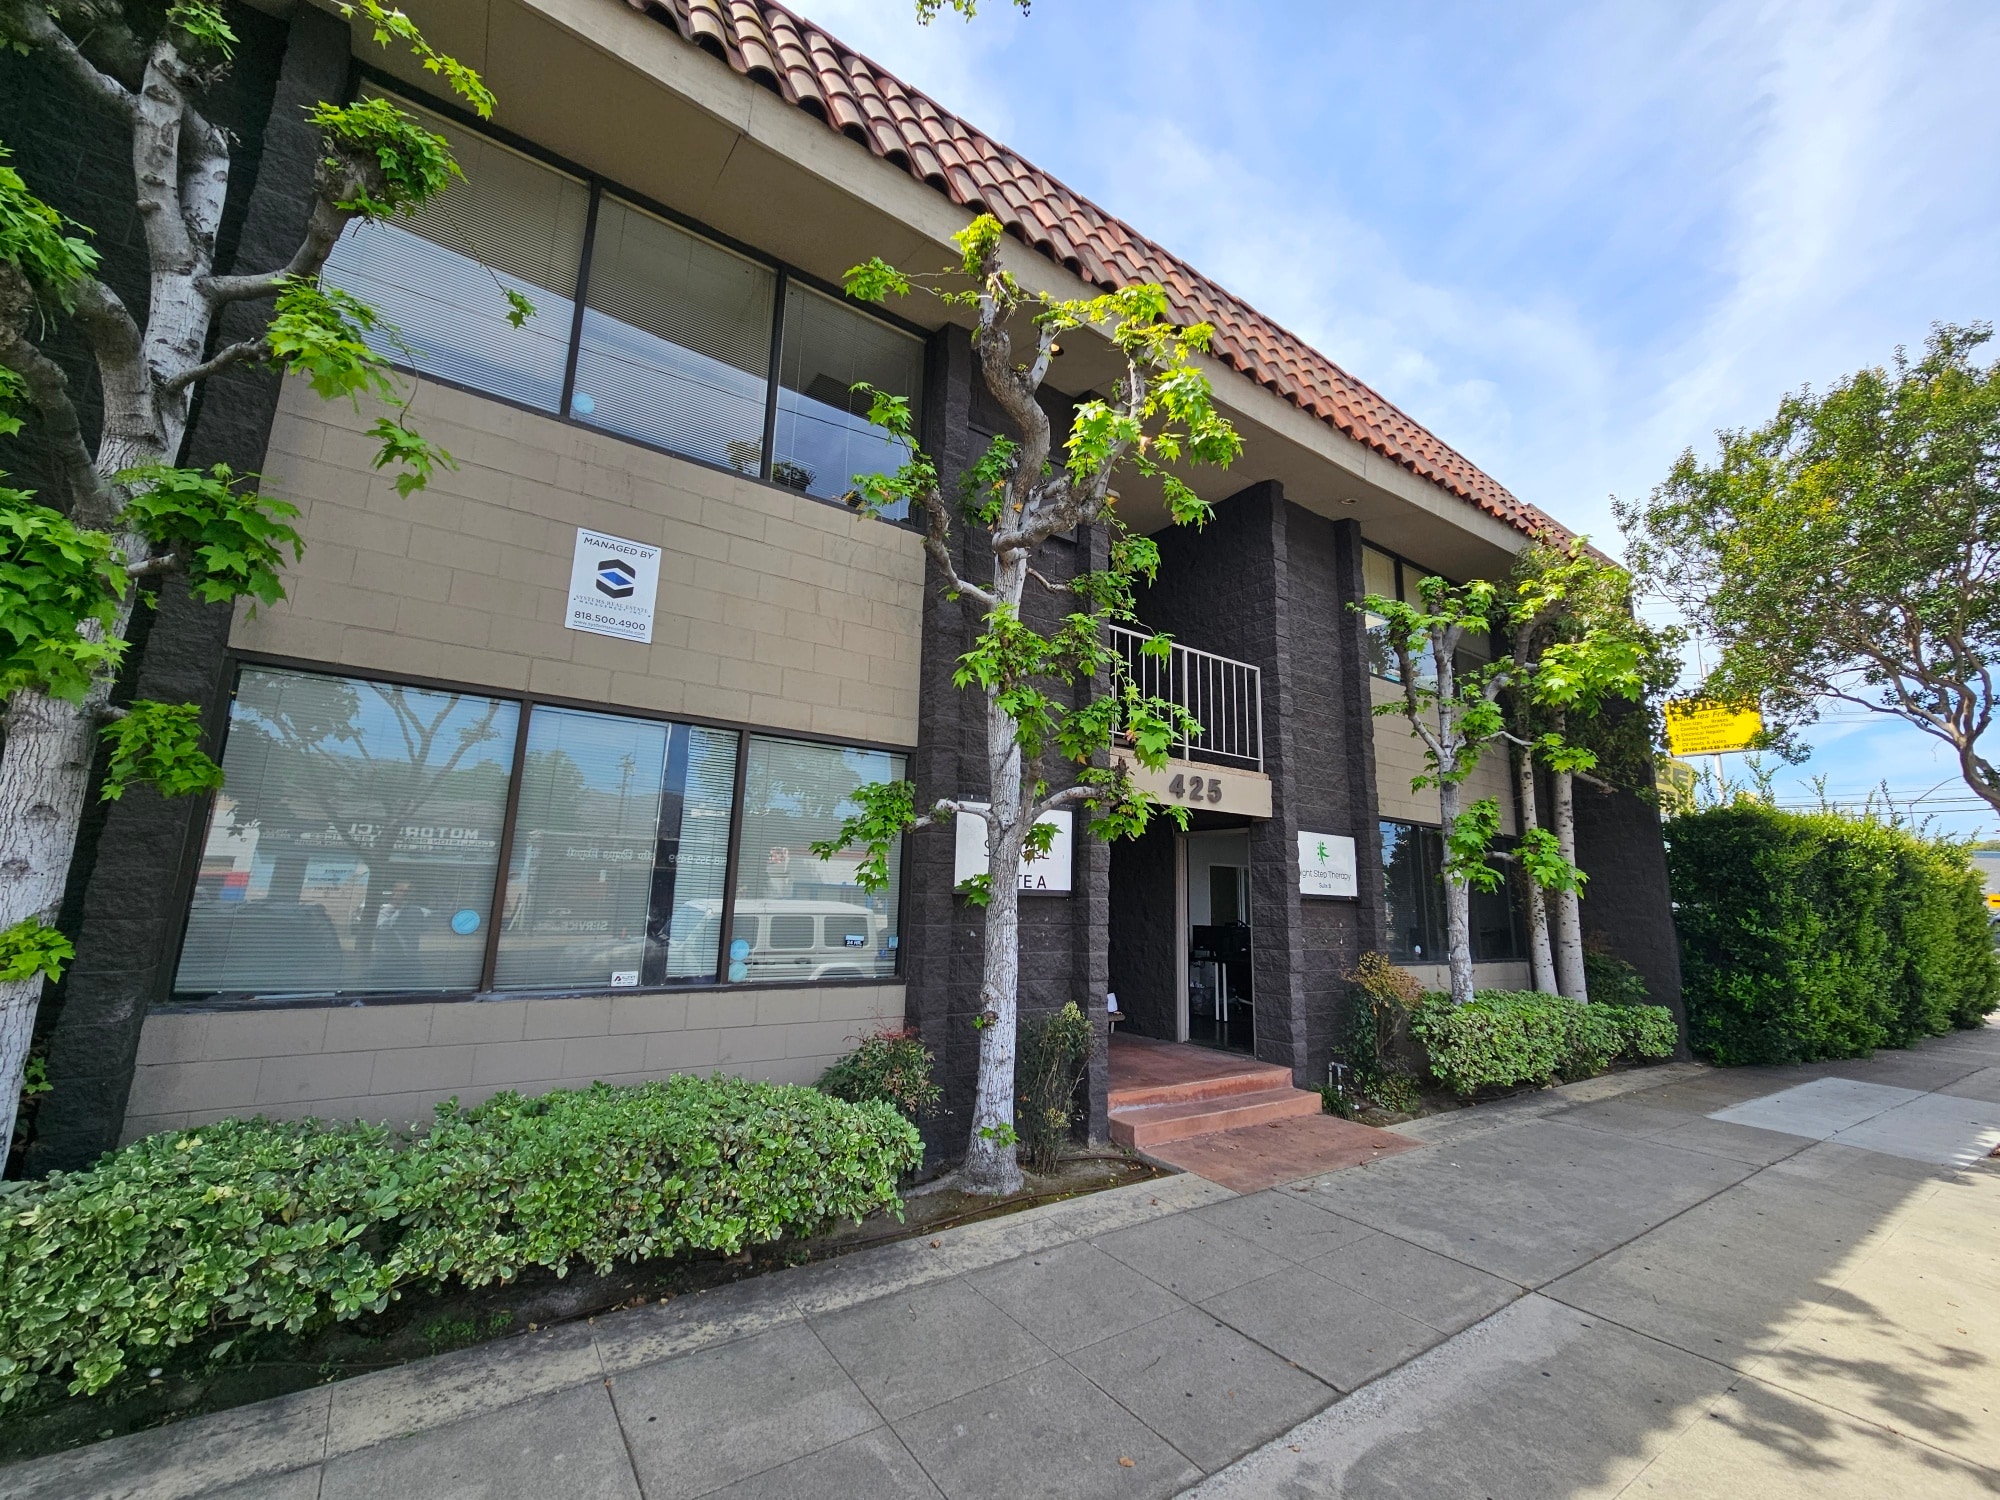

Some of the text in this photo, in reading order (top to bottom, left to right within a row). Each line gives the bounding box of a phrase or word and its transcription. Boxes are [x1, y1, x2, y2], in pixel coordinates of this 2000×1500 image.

[584, 537, 654, 560] MANAGED BY
[576, 594, 605, 604] SYSTEMS
[626, 604, 648, 614] ESTATE
[574, 610, 646, 630] 818.500.4900
[1168, 774, 1222, 804] 425
[1036, 875, 1046, 888] A
[1314, 870, 1327, 878] Step
[1328, 870, 1352, 881] Therapy
